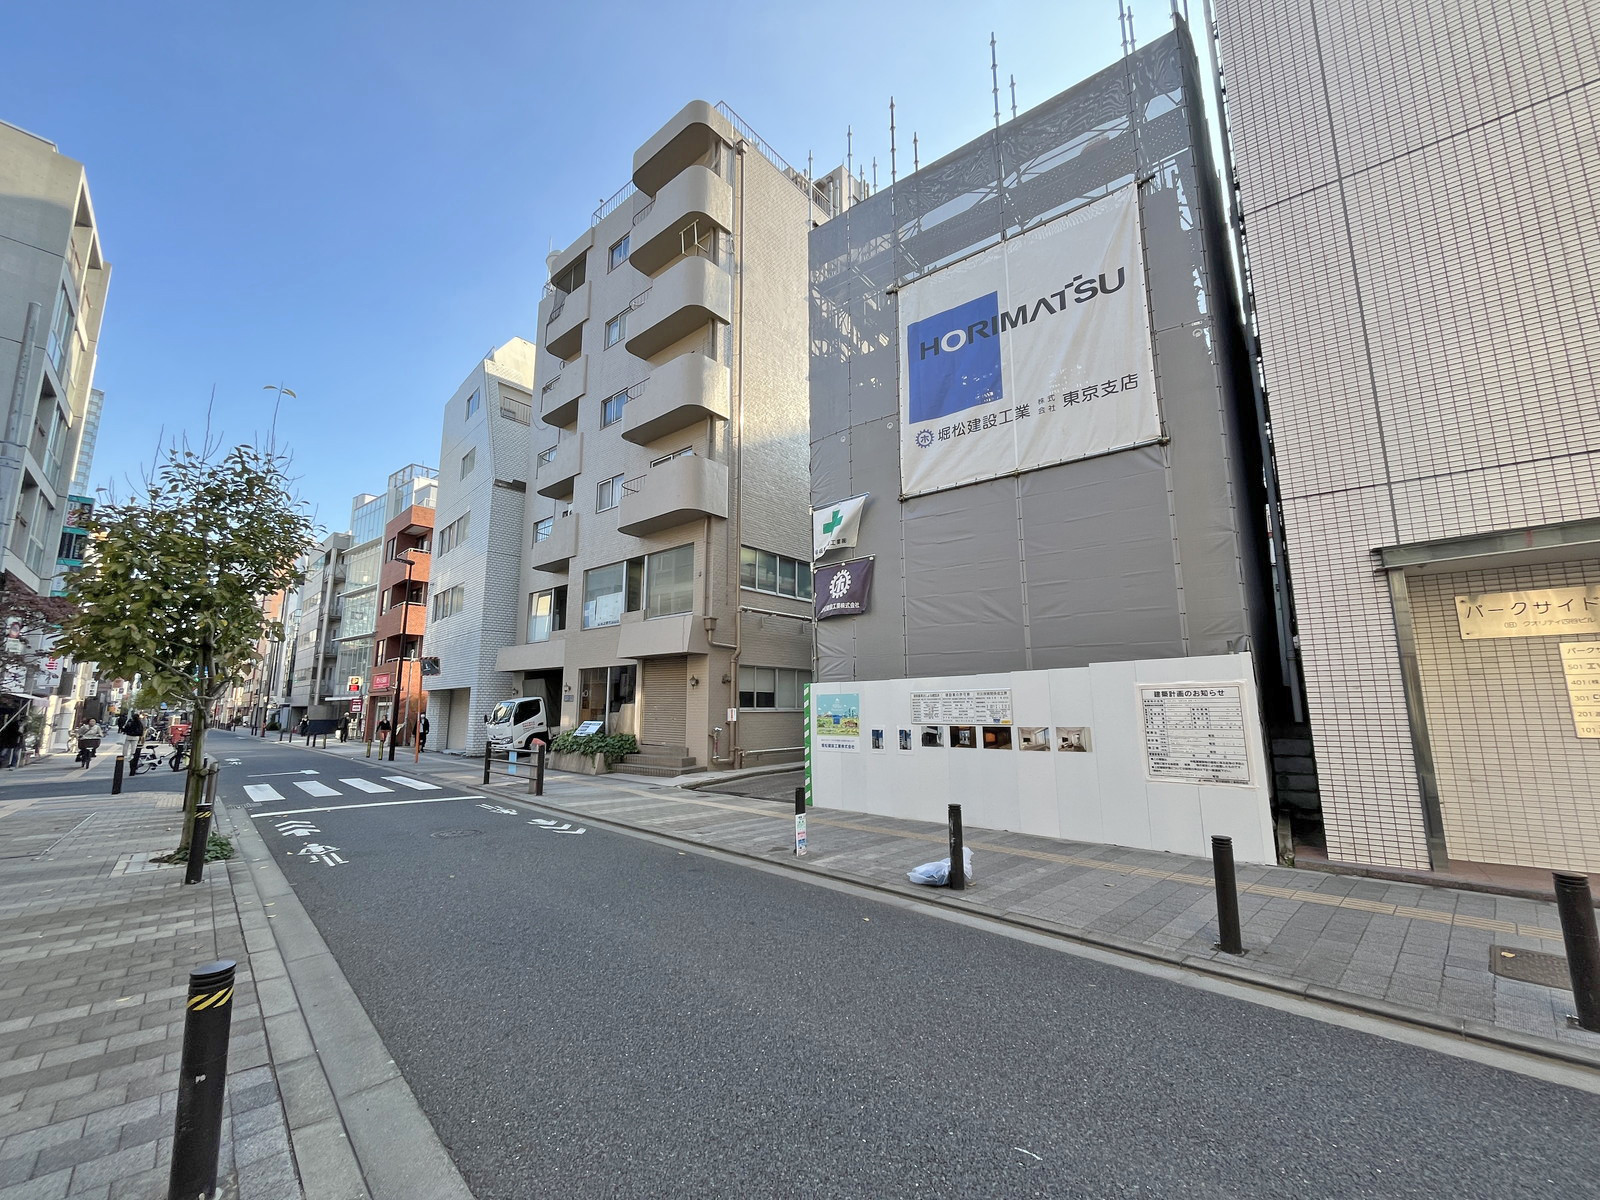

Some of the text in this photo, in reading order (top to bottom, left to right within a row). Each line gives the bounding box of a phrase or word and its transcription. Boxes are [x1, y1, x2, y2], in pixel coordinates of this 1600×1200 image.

[920, 267, 1125, 360] HORIMATSU
[937, 403, 1031, 442] 堀松建設工業
[1062, 373, 1139, 408] 東京支店
[1153, 689, 1225, 698] 建築計画のお知らせ
